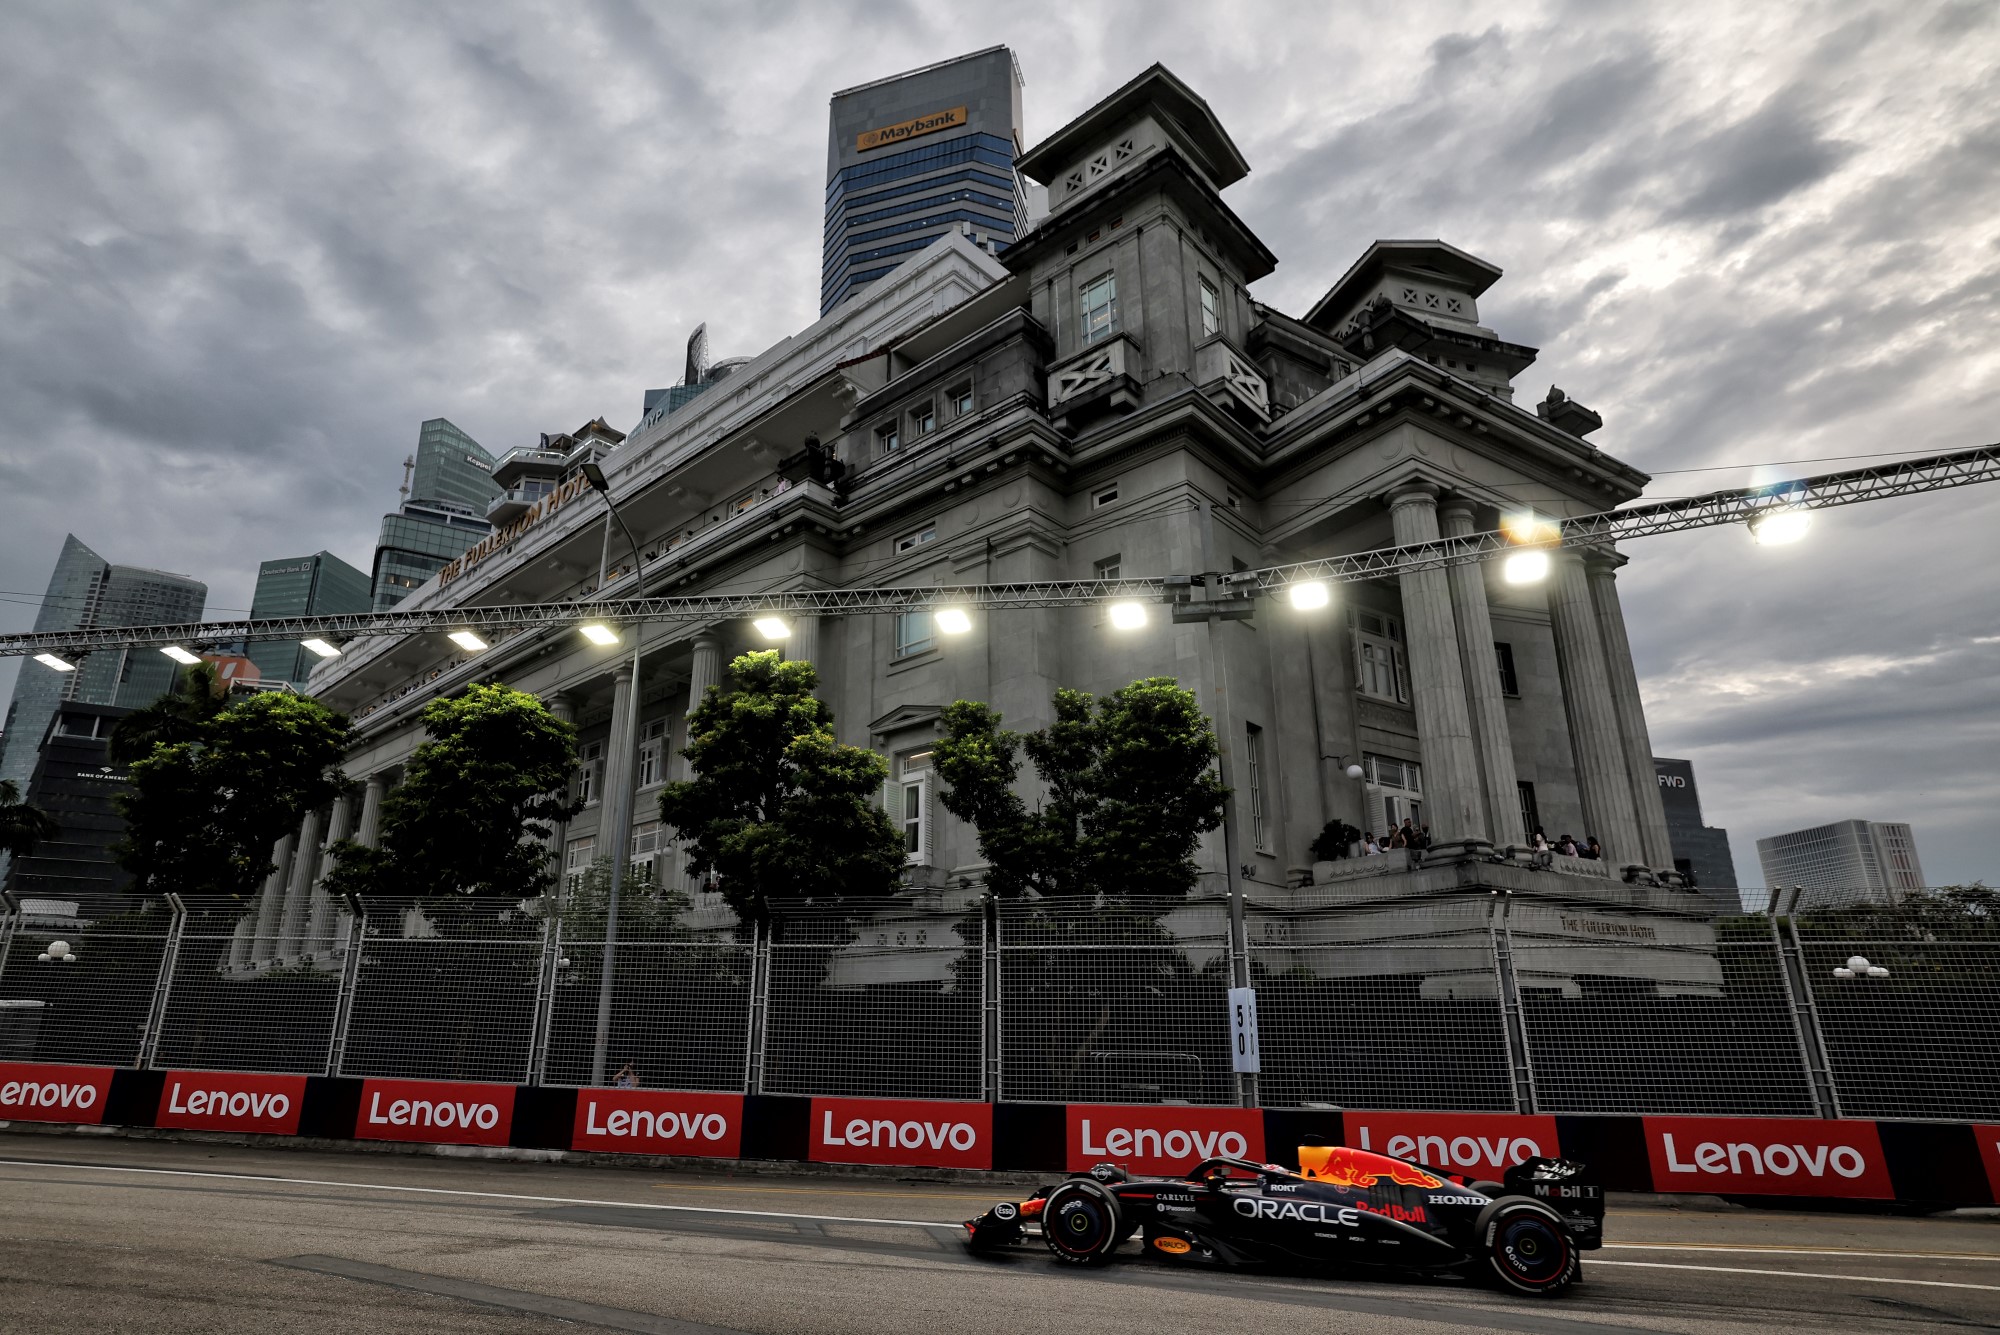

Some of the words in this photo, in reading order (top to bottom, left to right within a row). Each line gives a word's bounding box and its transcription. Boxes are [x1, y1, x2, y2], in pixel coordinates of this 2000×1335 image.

[880, 112, 955, 141] Maybank
[466, 455, 492, 471] Keppel
[438, 557, 462, 587] THE
[463, 501, 543, 570] FULLERTON
[546, 472, 591, 515] HOTE
[1657, 774, 1686, 788] FWD
[1560, 915, 1579, 932] THE
[1580, 920, 1629, 937] FULLERTON
[1630, 924, 1657, 940] HOTEL
[0, 1081, 97, 1109] enovo
[168, 1082, 290, 1119] Lenovo
[369, 1091, 499, 1130] Lenovo
[586, 1101, 727, 1141] Lenovo
[823, 1110, 976, 1151] Lenovo
[1081, 1119, 1248, 1161] Lenovo
[1662, 1133, 1865, 1179] Lenovo
[1156, 1193, 1196, 1202] CARLYLE
[1270, 1184, 1297, 1193] ROKT
[1534, 1184, 1581, 1198] Mobil
[998, 1206, 1013, 1215] Esso
[1233, 1198, 1360, 1227] ORACLE
[1391, 1204, 1427, 1223] Bull
[1508, 1253, 1528, 1272] Gate
